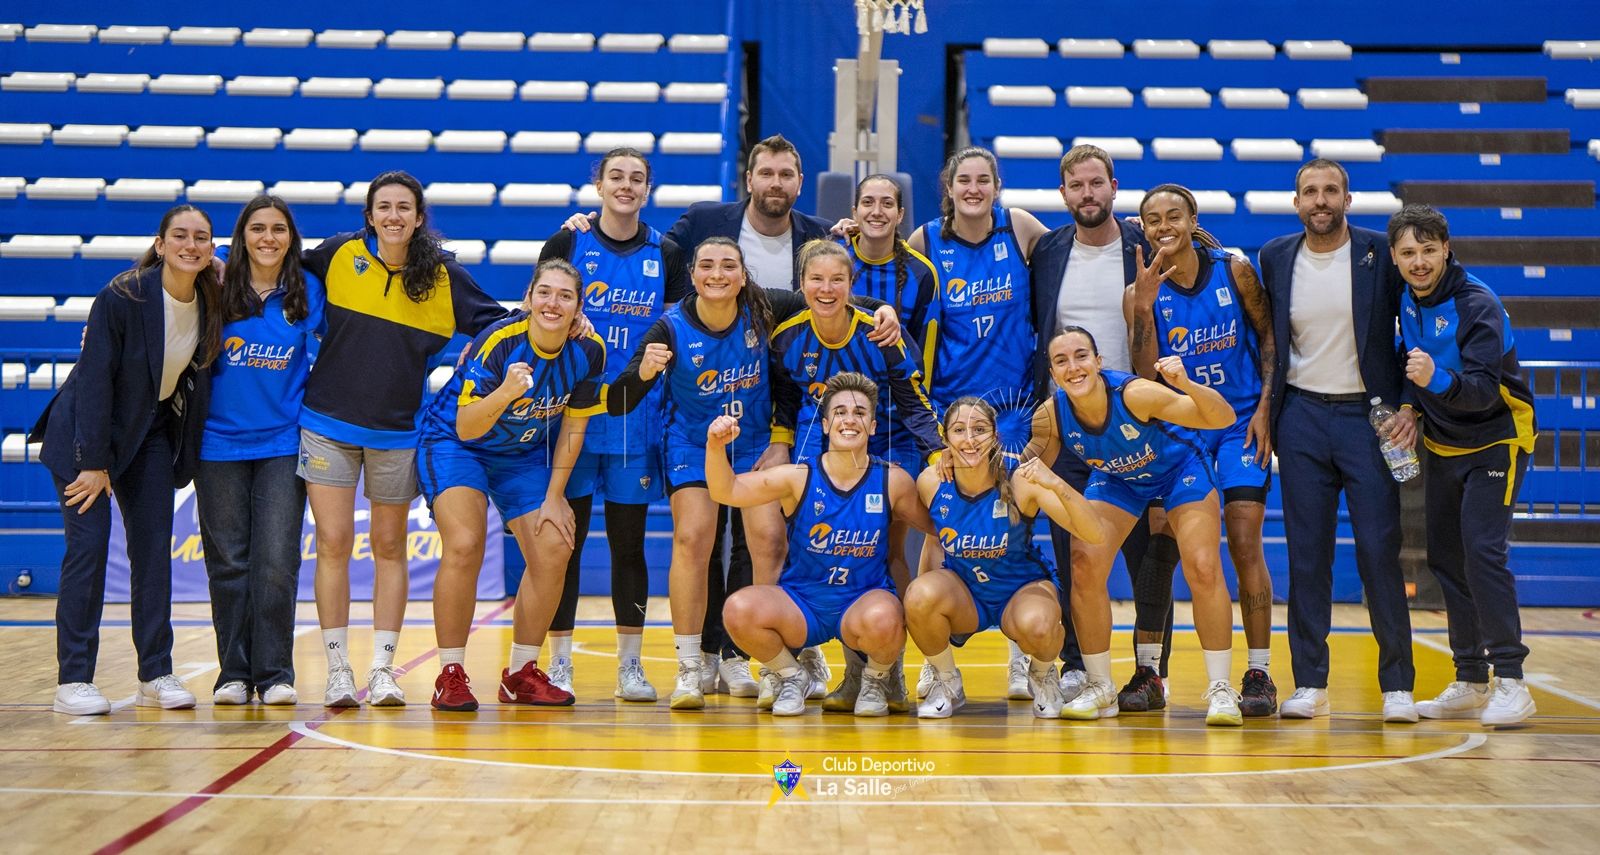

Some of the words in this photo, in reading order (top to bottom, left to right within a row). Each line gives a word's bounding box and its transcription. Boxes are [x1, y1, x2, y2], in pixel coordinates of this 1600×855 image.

[972, 288, 1014, 306] DEPORTE
[611, 303, 653, 317] DEPORTE
[972, 314, 995, 339] 17
[607, 325, 630, 350] 41
[1196, 335, 1238, 355] DEPORTE
[247, 357, 290, 371] DEPORTE
[1194, 362, 1226, 387] 55
[519, 428, 537, 443] 8
[833, 545, 877, 557] DEPORTE
[963, 547, 1006, 559] DEPORTE
[828, 566, 850, 585] 13
[972, 566, 990, 583] 6
